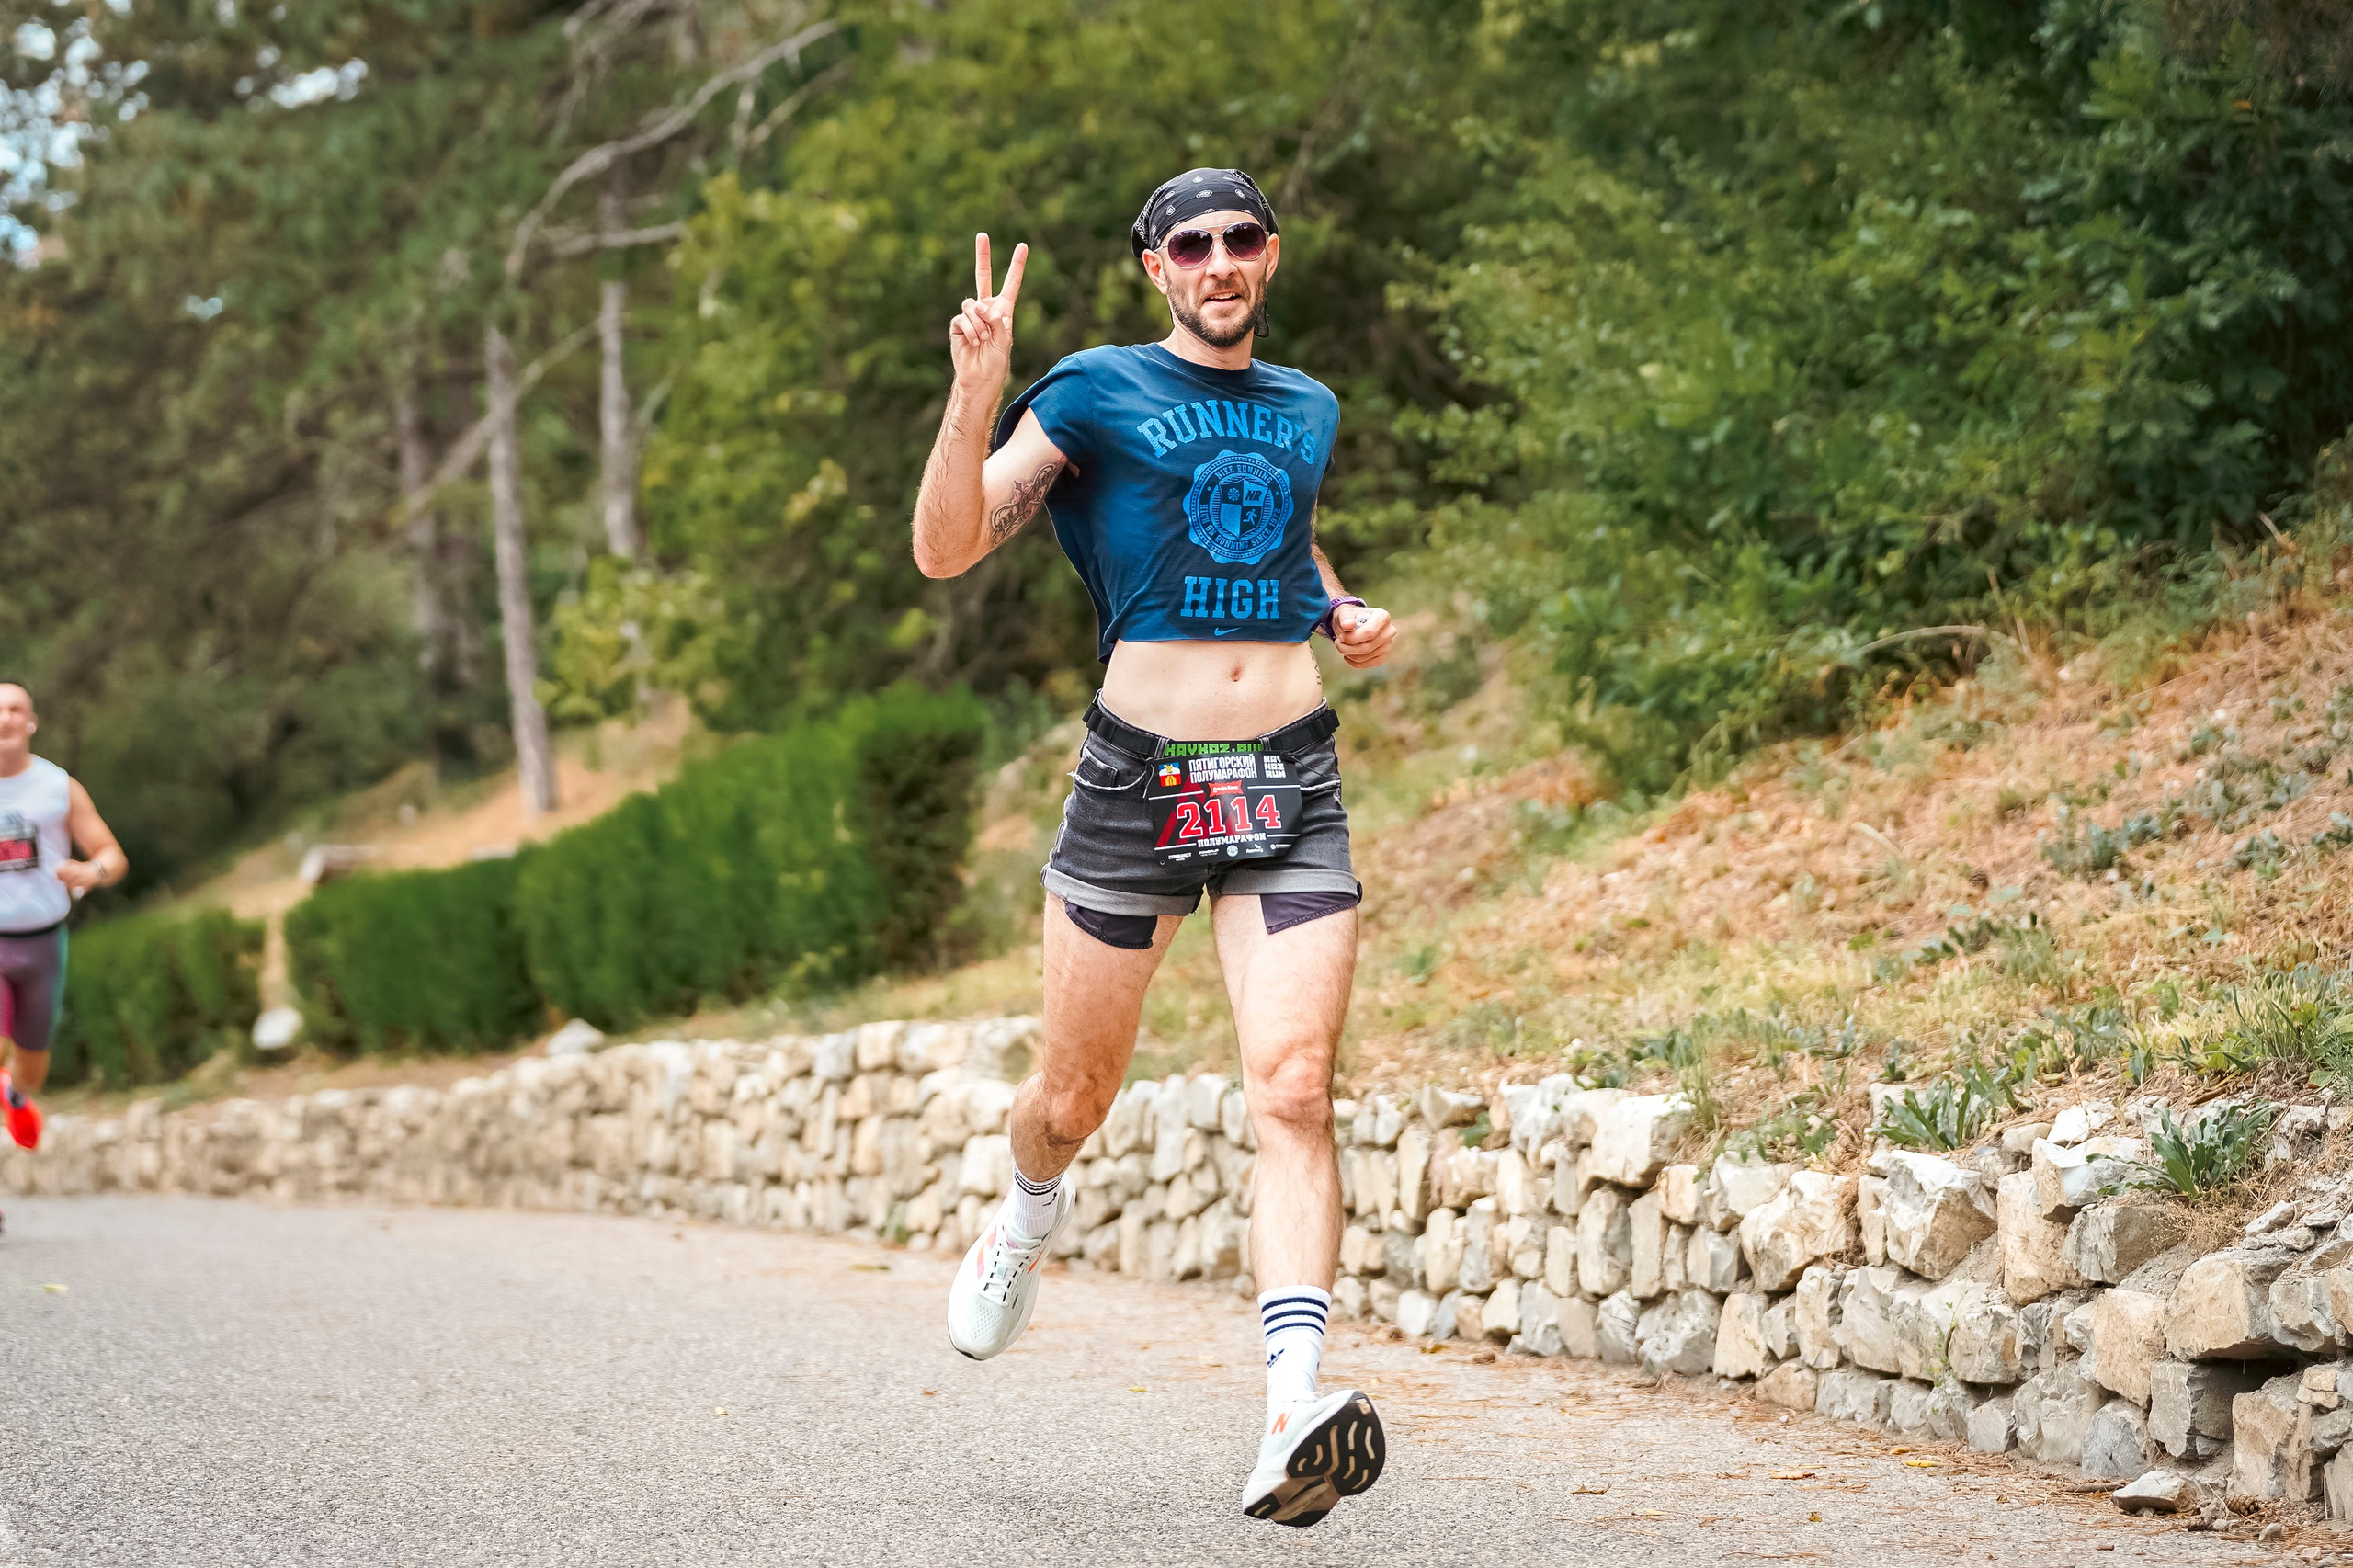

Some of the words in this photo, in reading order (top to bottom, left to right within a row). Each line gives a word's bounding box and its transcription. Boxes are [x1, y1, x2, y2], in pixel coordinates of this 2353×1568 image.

[1137, 399, 1317, 465] RUNNER'S
[1214, 465, 1235, 480] NIKE
[1236, 464, 1273, 483] RUNNING
[1199, 504, 1209, 525] HIGH
[1205, 524, 1217, 537] ON
[1214, 536, 1249, 551] RUNNING
[1251, 527, 1272, 547] SINCE
[1268, 507, 1281, 528] 1972
[1180, 575, 1280, 619] HIGH
[1188, 754, 1257, 772] ПЯТИГОРСКИЙ
[1189, 767, 1258, 784] ПОЛУМАРАФОН
[1176, 794, 1282, 839] 2114
[1198, 832, 1267, 848] ПОЛУМАРАФОН
